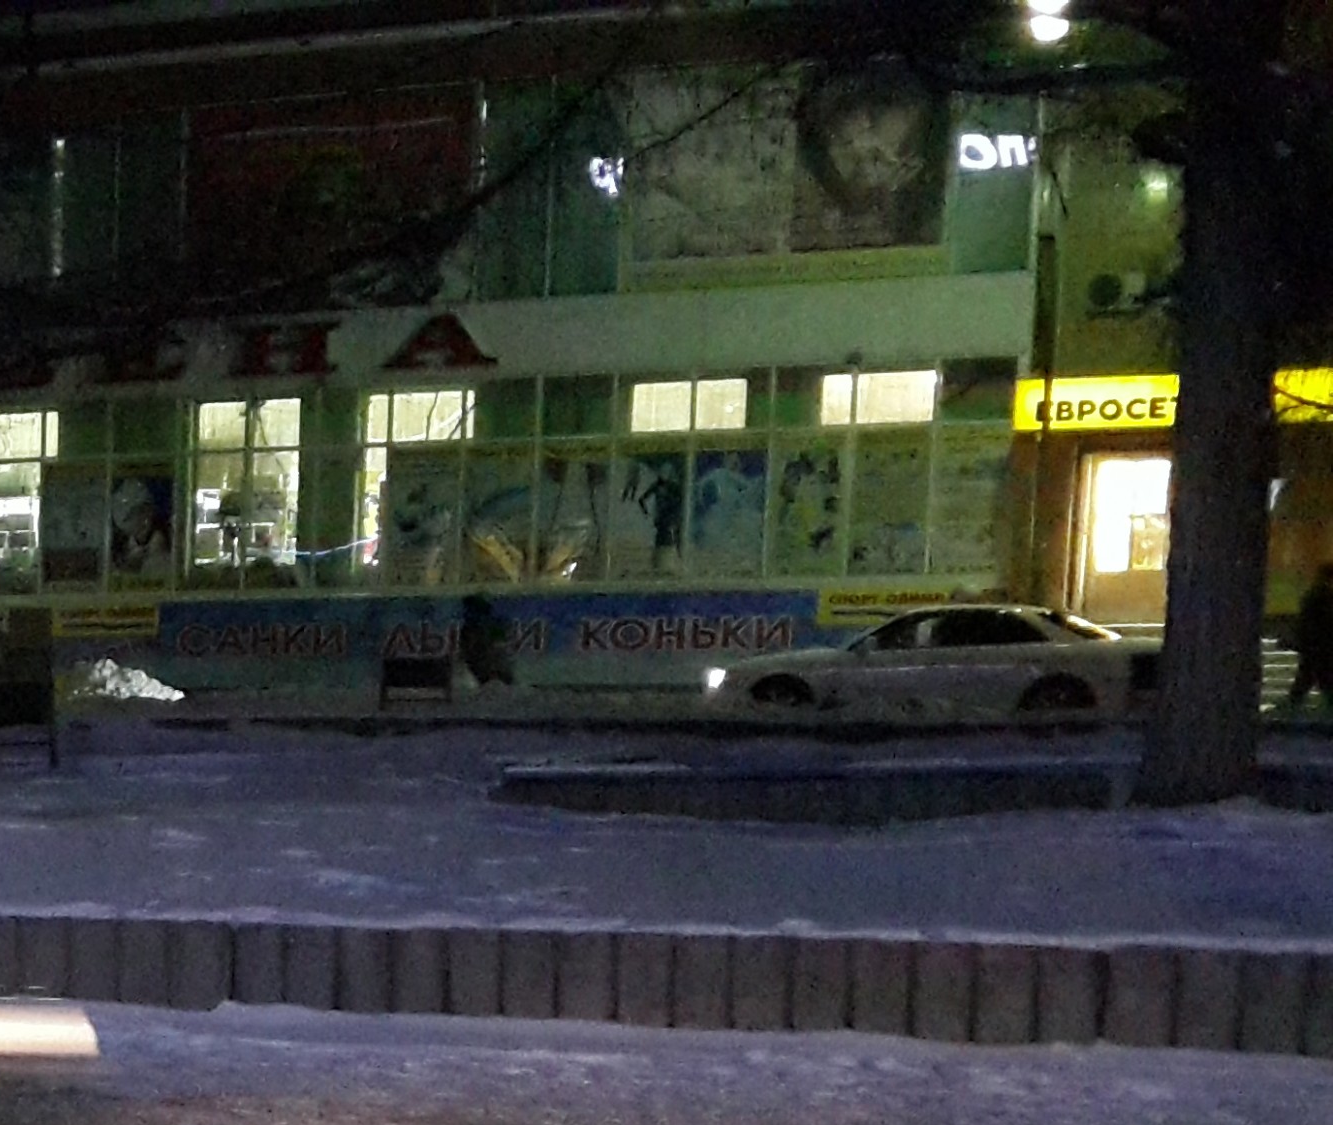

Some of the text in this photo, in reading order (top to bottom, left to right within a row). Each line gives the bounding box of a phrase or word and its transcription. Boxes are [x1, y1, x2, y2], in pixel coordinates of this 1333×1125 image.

[1036, 396, 1178, 423] ЕВРОСЕ
[177, 615, 792, 657] САНКИ ЛЫИ КОНЬКИ
